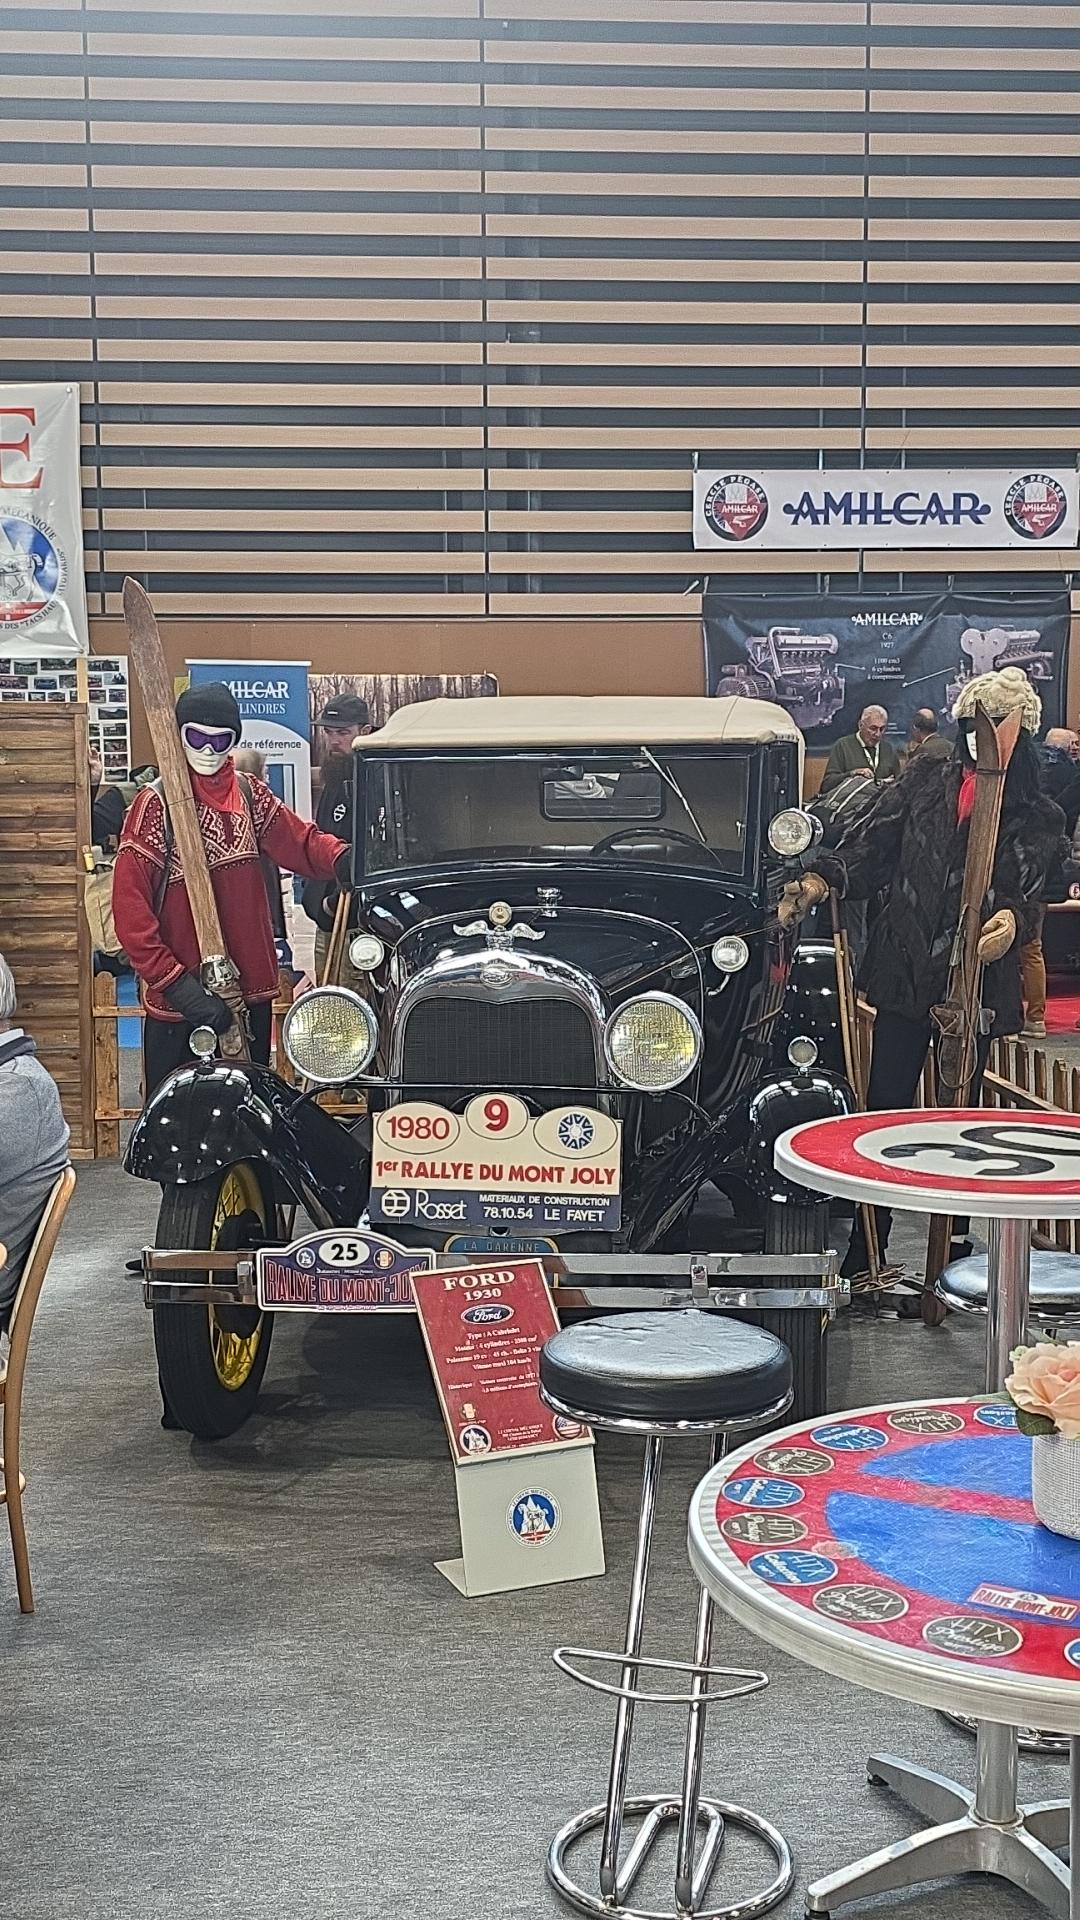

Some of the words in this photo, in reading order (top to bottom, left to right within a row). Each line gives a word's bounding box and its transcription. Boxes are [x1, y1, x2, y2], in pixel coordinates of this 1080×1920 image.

[705, 479, 726, 517] CERCLE
[1005, 479, 1026, 516] CERCLE
[722, 504, 758, 514] AMILCAR
[783, 491, 991, 526] AMILCAR
[1020, 503, 1057, 513] AMILCAR
[852, 612, 923, 626] AMILCAR
[240, 740, 253, 749] de
[255, 739, 301, 749] référence
[484, 1098, 509, 1132] 9
[386, 1116, 450, 1140] 1980
[881, 1125, 1080, 1176] 30
[376, 1161, 398, 1177] 1er
[401, 1161, 473, 1180] RALLYE
[480, 1163, 503, 1181] DU
[508, 1165, 565, 1183] MONT
[570, 1167, 616, 1185] JOLY
[415, 1189, 467, 1220] Rosset
[479, 1194, 526, 1204] MATERIAUX
[528, 1195, 540, 1204] DE
[544, 1196, 610, 1207] CONSTRUCTION
[483, 1206, 533, 1219] 78.10.54
[544, 1208, 560, 1220] LE
[566, 1210, 605, 1222] FAYET
[331, 1243, 358, 1261] 25
[464, 1241, 477, 1251] LA
[487, 1243, 540, 1253] GARENNE
[266, 1260, 317, 1301] RALLYE
[319, 1277, 340, 1302] DU
[442, 1270, 515, 1291] FORD
[463, 1287, 501, 1301] 1930
[472, 1308, 502, 1322] Ford
[467, 1332, 482, 1341] Type
[484, 1340, 510, 1349] cylindres
[908, 1419, 956, 1432] HTX
[836, 1433, 883, 1450] HTX
[788, 1455, 829, 1474] HTX
[762, 1484, 796, 1504] HTX
[767, 1519, 795, 1538] HTX
[788, 1553, 831, 1577] HTX
[846, 1586, 901, 1611] HTX
[974, 1589, 1013, 1608] RALLYE
[951, 1618, 1010, 1642] HTX
